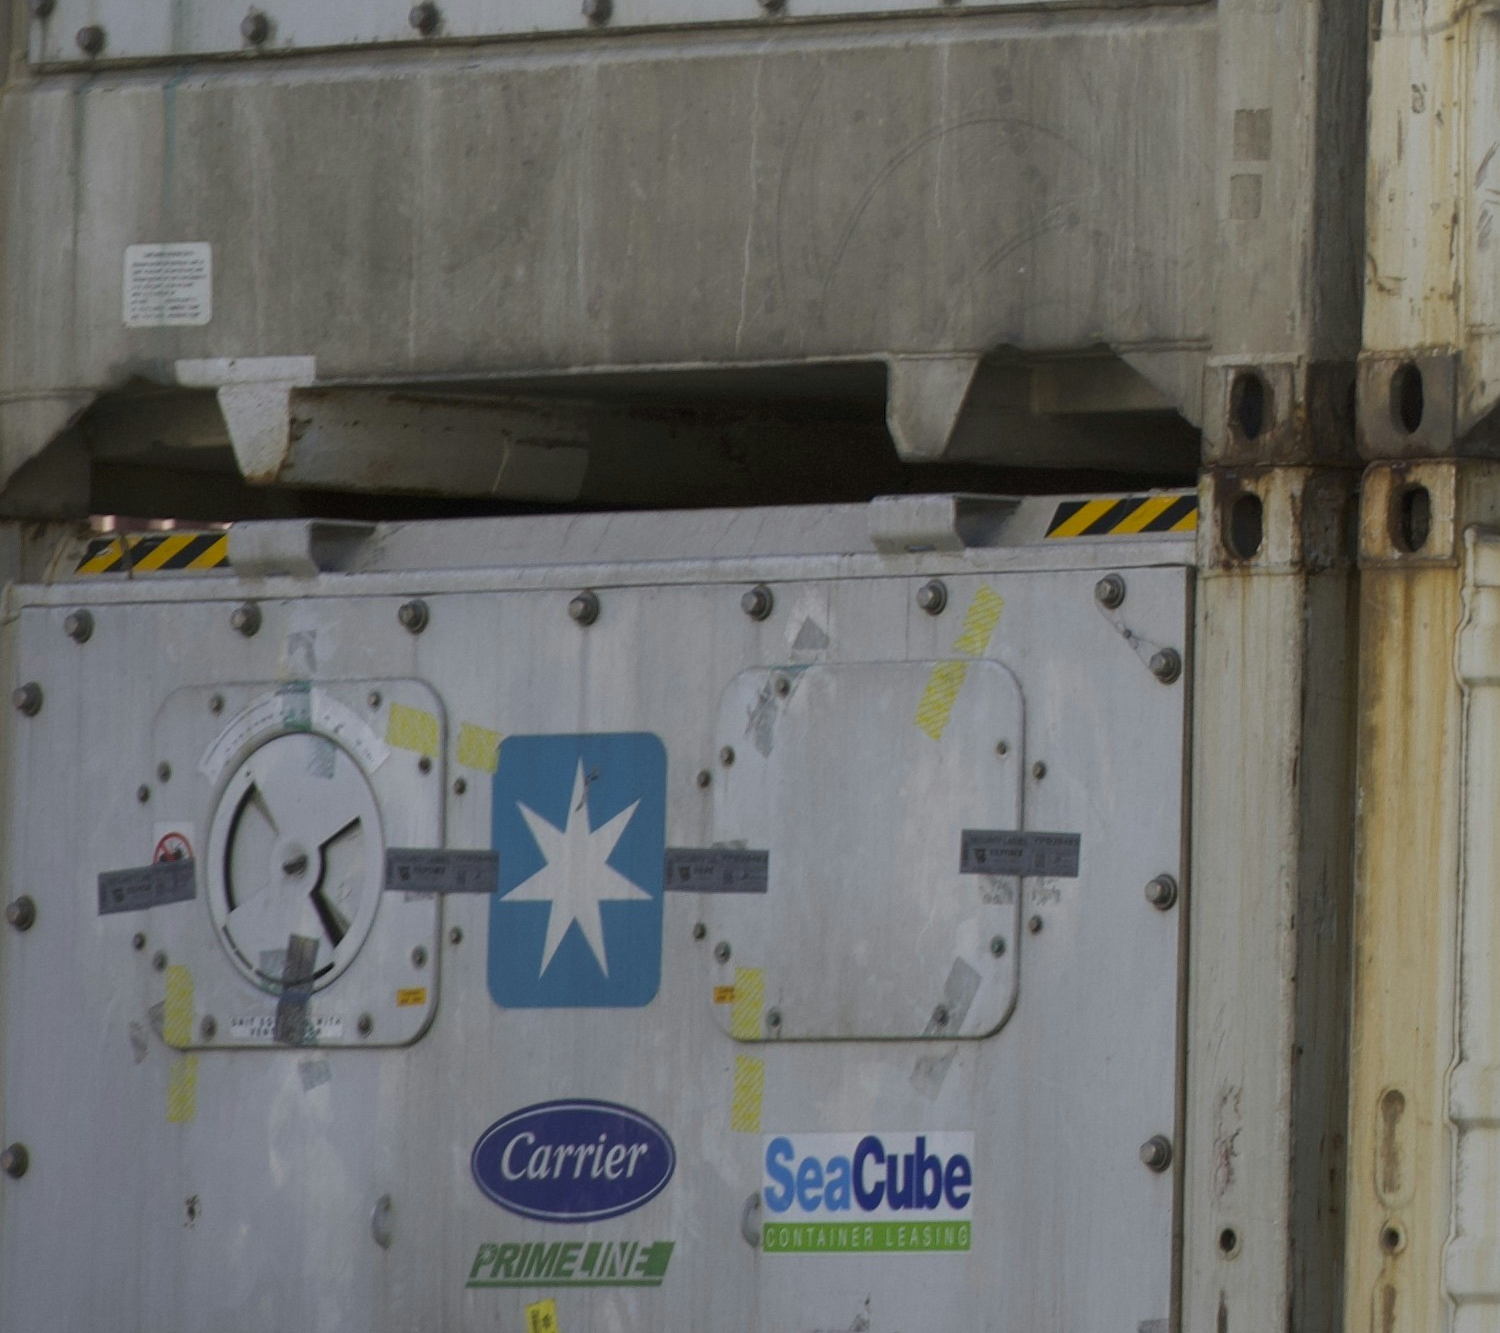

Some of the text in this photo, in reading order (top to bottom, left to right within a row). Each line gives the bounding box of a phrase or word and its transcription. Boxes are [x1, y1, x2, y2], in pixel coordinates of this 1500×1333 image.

[498, 1130, 650, 1183] Carrier
[764, 1134, 973, 1213] SeaCube
[766, 1222, 972, 1249] CONTAINER LEASING
